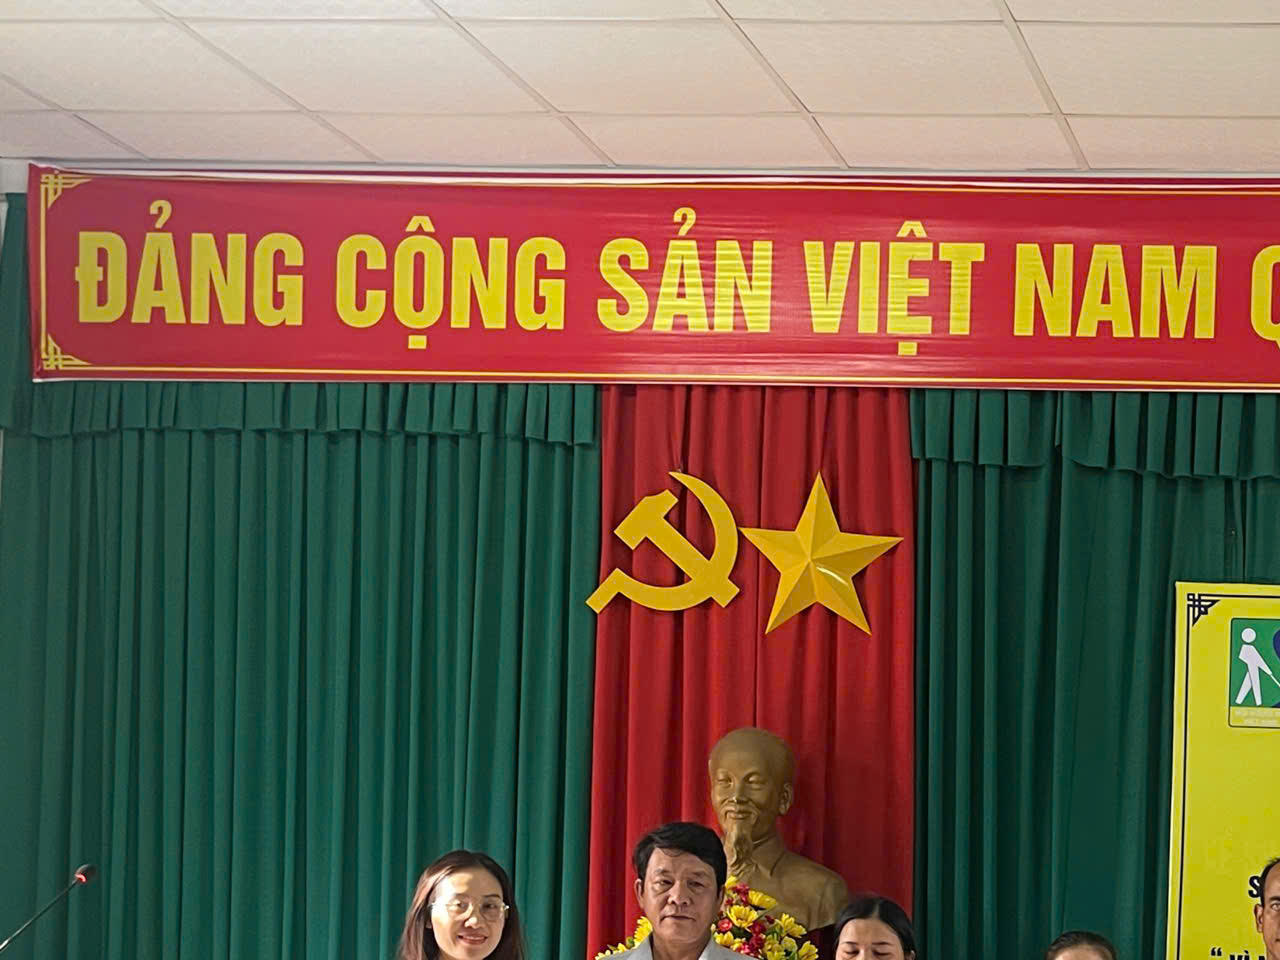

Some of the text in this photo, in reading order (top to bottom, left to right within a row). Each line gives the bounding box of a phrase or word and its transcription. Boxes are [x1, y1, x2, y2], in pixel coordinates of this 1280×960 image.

[76, 200, 303, 326] ĐẢNG
[336, 216, 565, 349] CỘNG
[596, 206, 774, 333] SẢN
[804, 221, 984, 355] VIỆT
[1014, 244, 1216, 338] NAM
